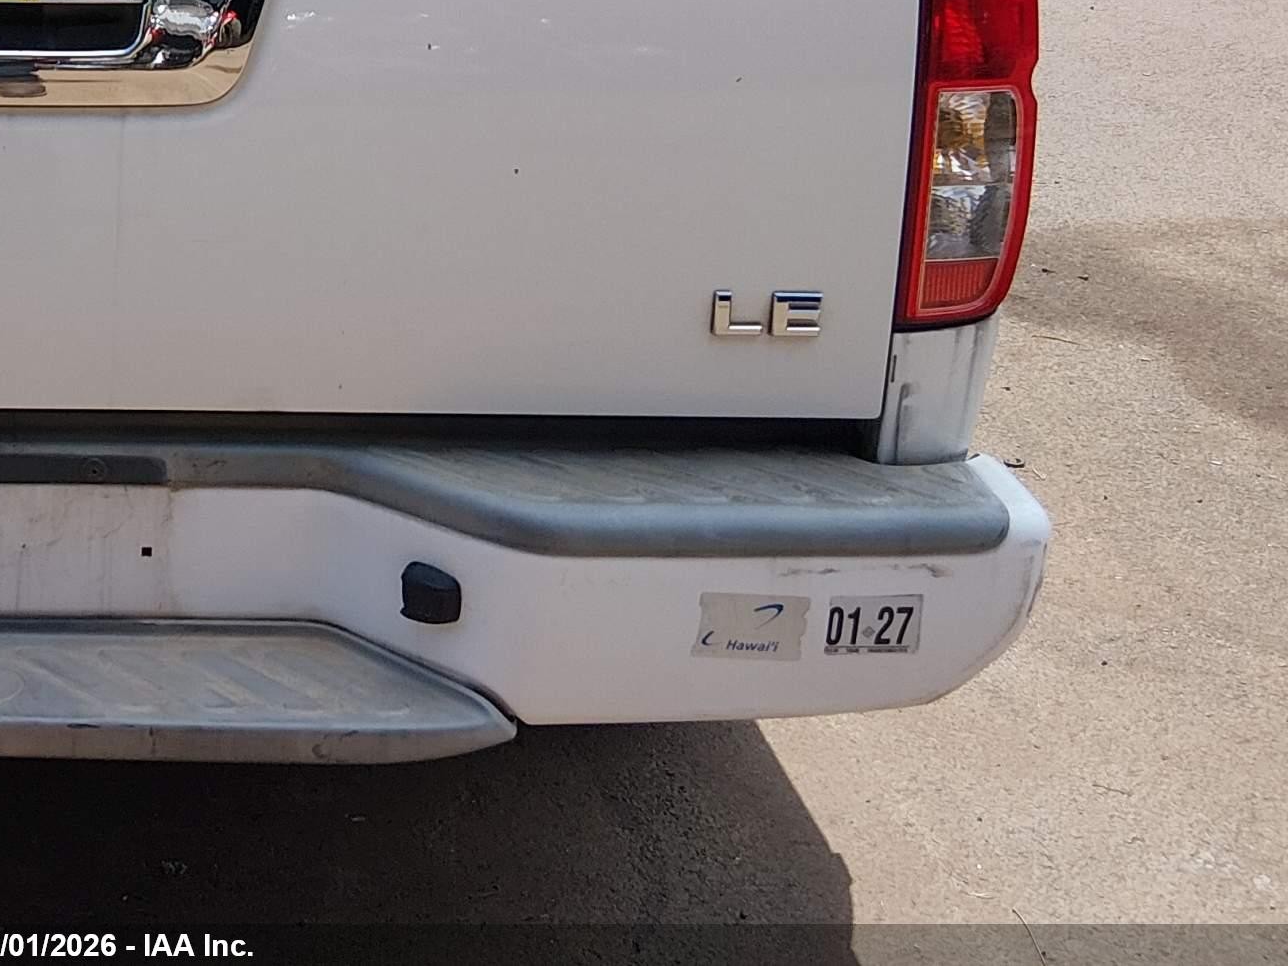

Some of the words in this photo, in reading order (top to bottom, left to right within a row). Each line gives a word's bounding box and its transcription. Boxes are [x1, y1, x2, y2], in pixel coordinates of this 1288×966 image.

[711, 290, 824, 338] LE
[825, 606, 862, 646] 01
[873, 606, 915, 646] 27
